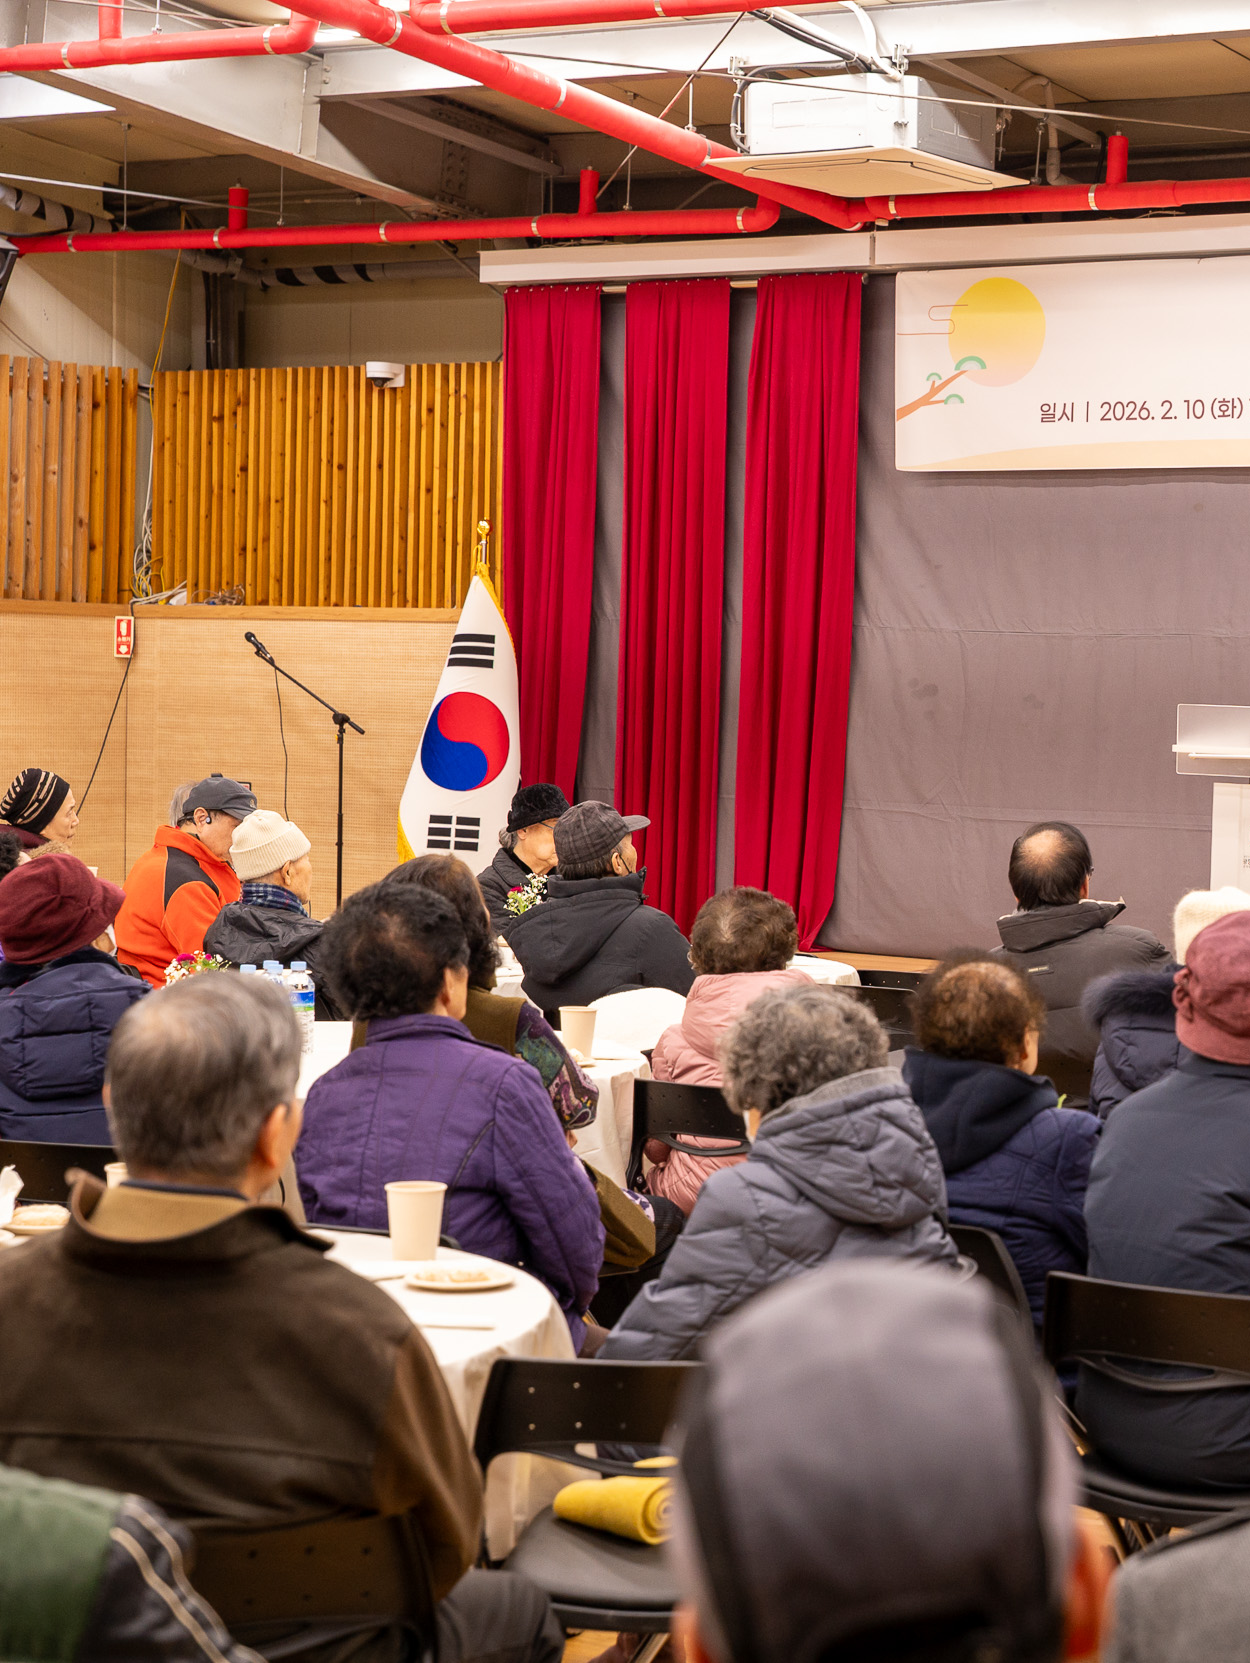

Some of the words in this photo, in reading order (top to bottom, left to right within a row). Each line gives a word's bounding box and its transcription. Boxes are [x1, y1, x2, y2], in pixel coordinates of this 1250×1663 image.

[1040, 402, 1075, 423] 일시
[1099, 401, 1156, 421] 2026.
[1160, 400, 1178, 420] 2.
[1183, 399, 1205, 420] 10
[1210, 397, 1243, 420] (화)
